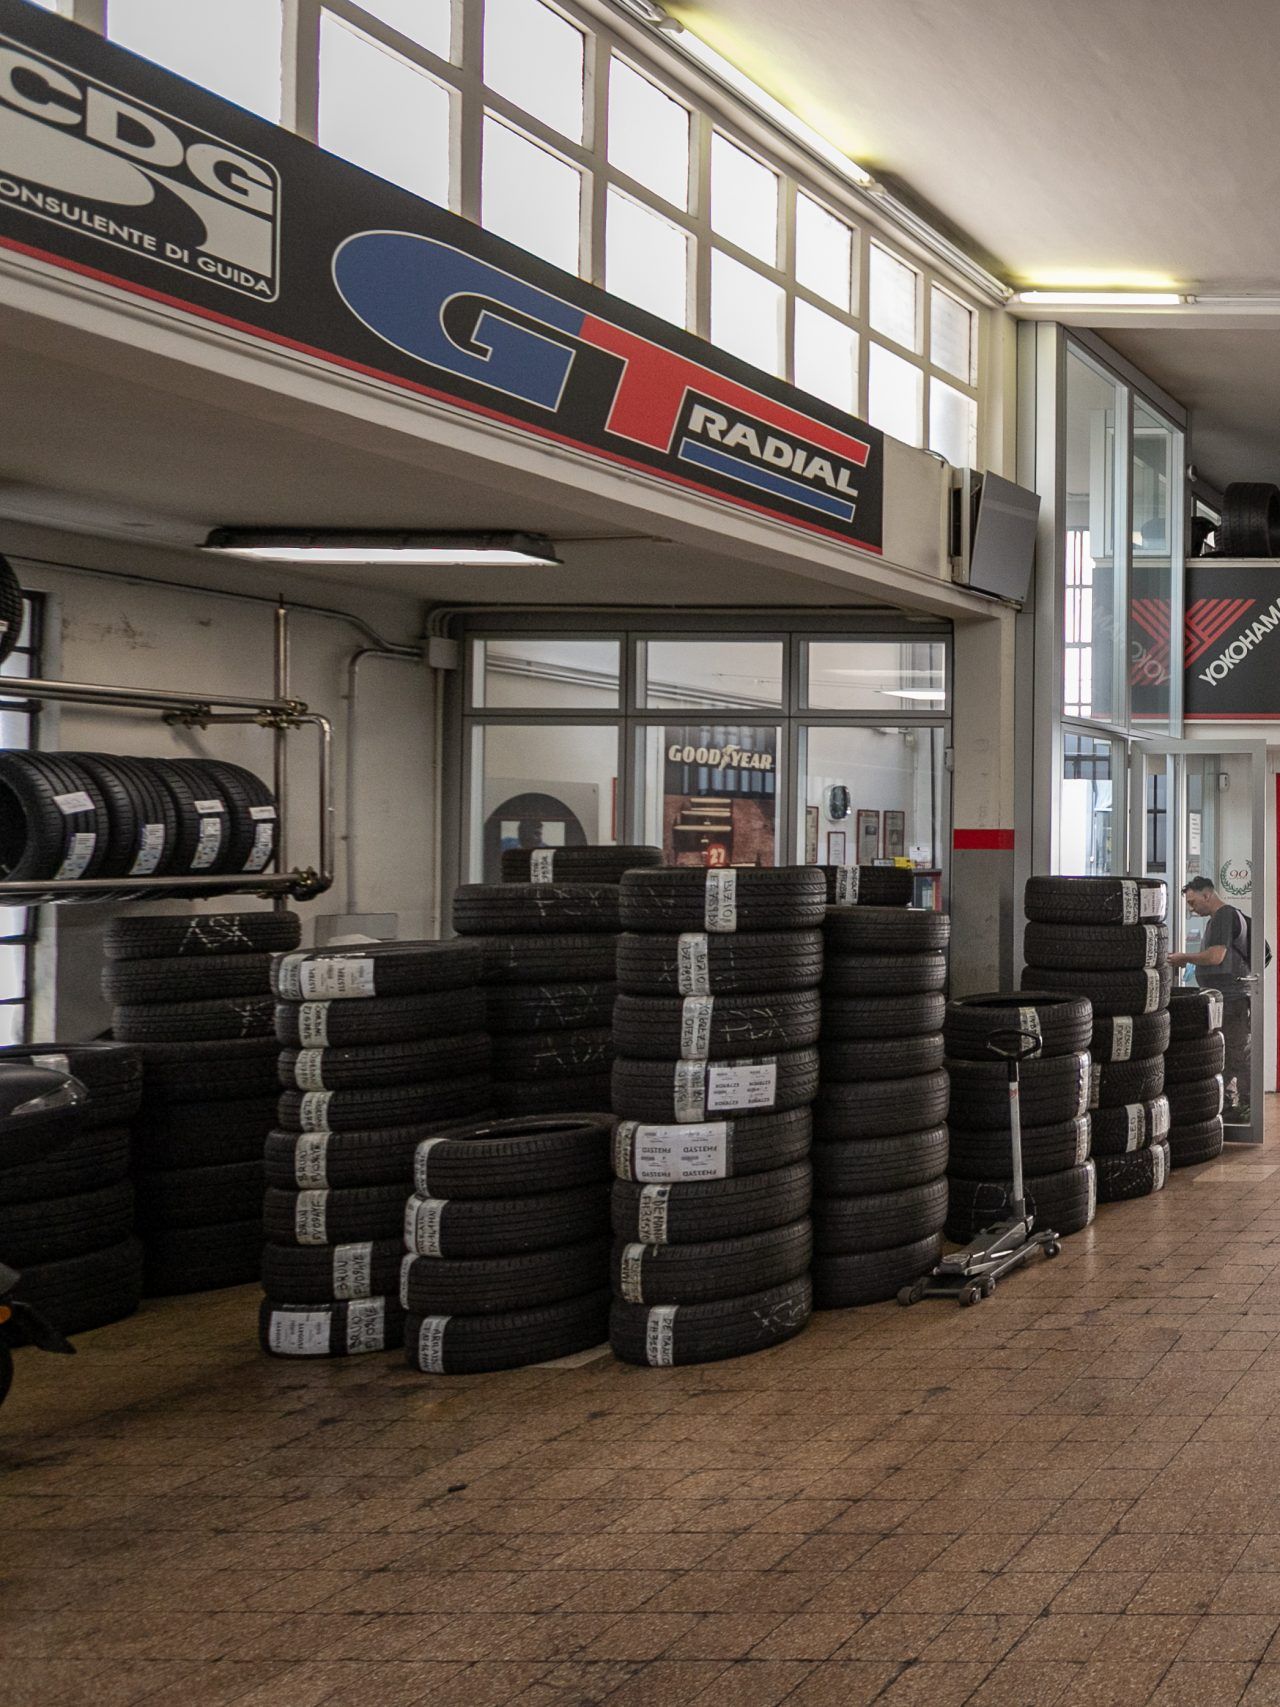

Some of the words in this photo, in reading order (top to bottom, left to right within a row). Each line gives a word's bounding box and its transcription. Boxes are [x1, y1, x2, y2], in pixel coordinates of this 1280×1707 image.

[0, 47, 274, 216] CDG
[0, 178, 157, 250] ONSULENTE
[165, 242, 190, 264] DI
[196, 256, 272, 296] GUIDA
[331, 229, 871, 467] GT
[688, 403, 858, 497] RADIAL
